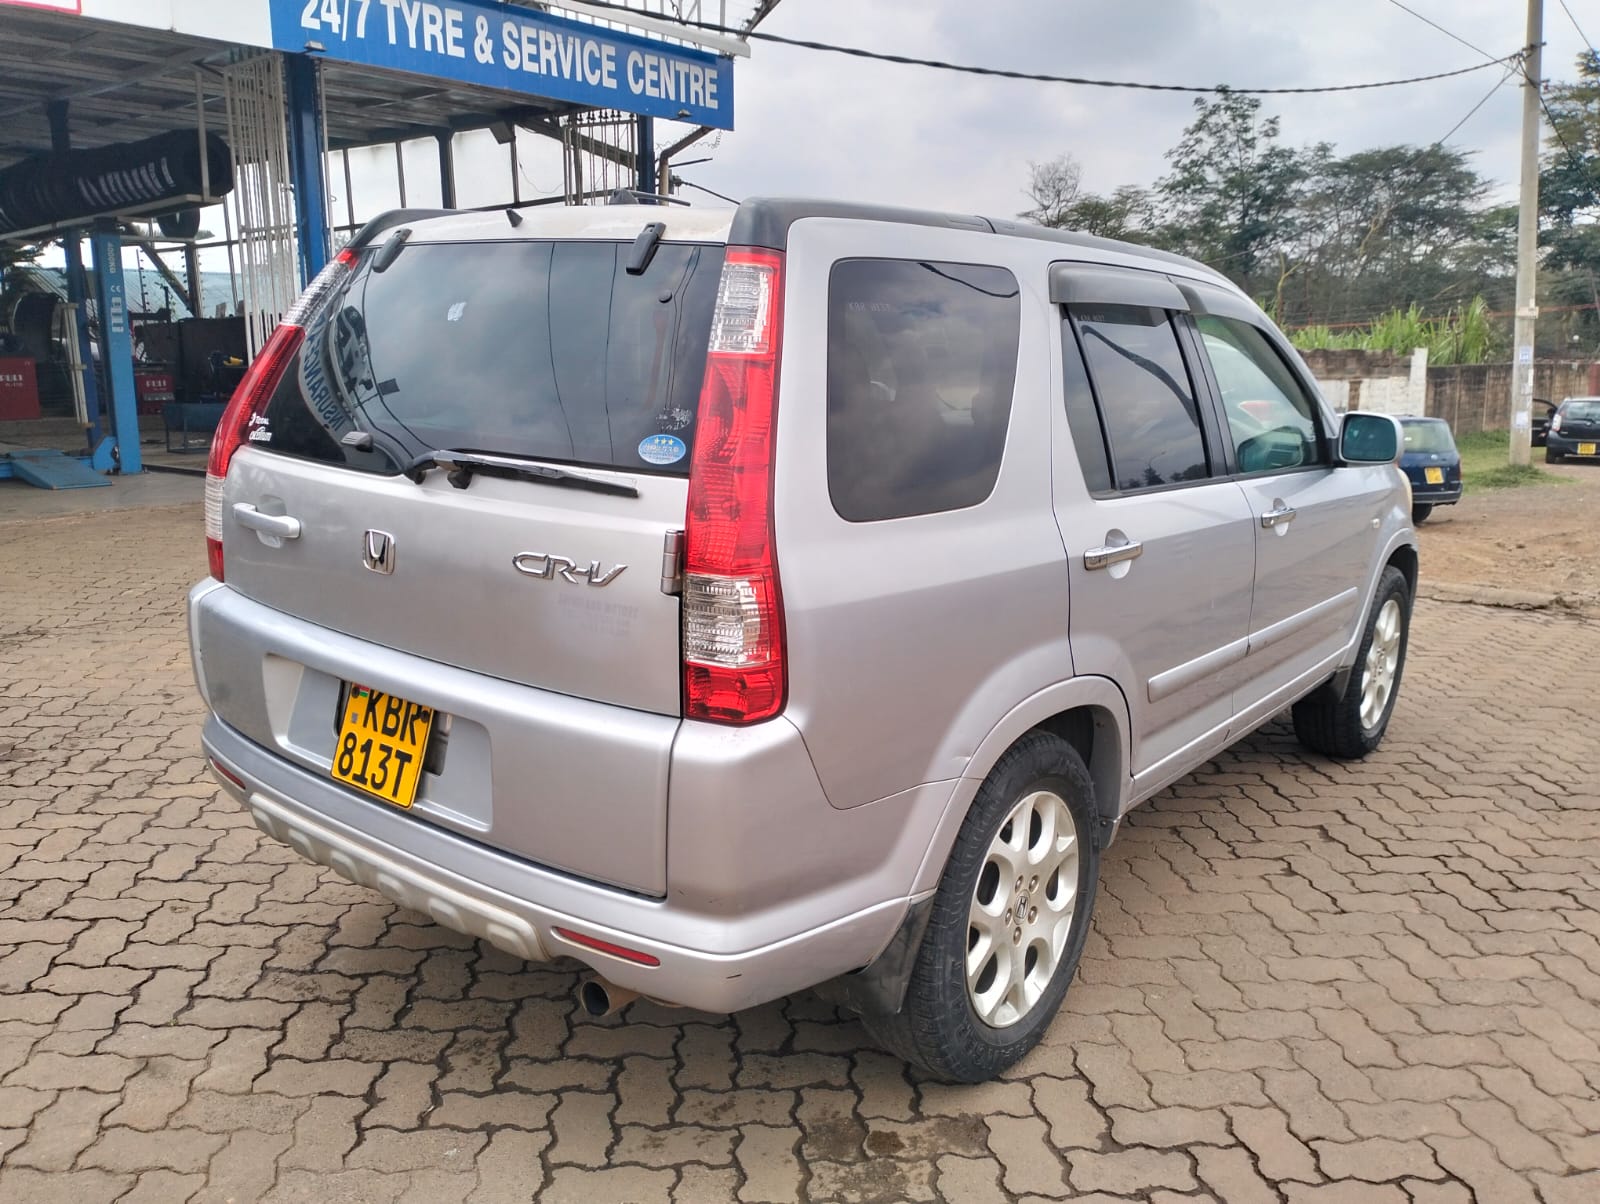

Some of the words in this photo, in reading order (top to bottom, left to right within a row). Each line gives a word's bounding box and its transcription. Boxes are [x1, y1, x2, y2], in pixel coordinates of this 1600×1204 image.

[301, 0, 370, 41] 24/7
[379, 0, 466, 58] TYRE
[473, 15, 495, 64] &
[502, 21, 617, 89] SERVICE
[627, 51, 718, 109] CENTRE
[512, 551, 628, 587] CR-V
[362, 689, 423, 746] KBR
[338, 732, 412, 798] 813T
